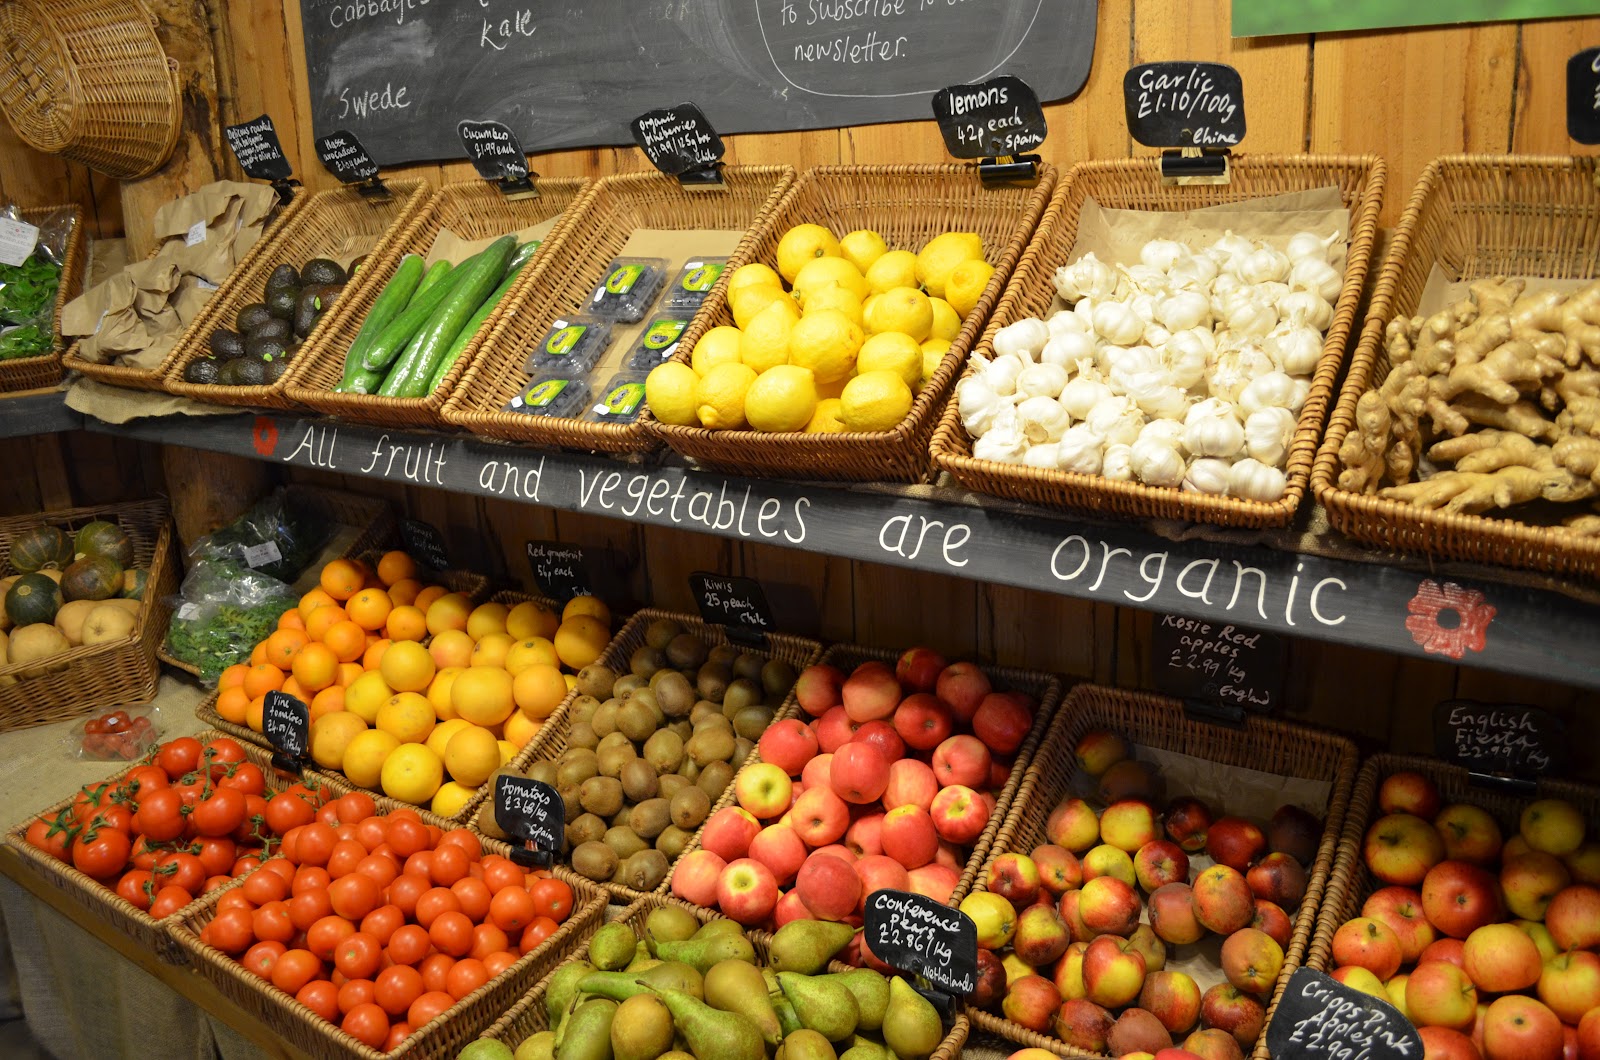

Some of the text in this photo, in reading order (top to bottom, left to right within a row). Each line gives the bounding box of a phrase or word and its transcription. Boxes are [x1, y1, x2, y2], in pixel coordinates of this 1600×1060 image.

[781, 0, 798, 26] to
[480, 8, 537, 51] Kale
[794, 31, 908, 64] newsletter.
[1139, 67, 1214, 93] Garlic
[338, 82, 412, 120] Swede
[949, 87, 1009, 115] lemons
[1138, 90, 1236, 124] £1.10/100g
[642, 120, 696, 146] blueberries
[957, 106, 1023, 148] 42p each
[475, 142, 516, 159] £1.99 each
[283, 425, 1347, 626] All fruit and vegetables are organic
[527, 543, 584, 565] Red grapefruit
[554, 566, 574, 578] each
[703, 578, 732, 593] Kiwis
[1180, 635, 1240, 658] apples
[1218, 625, 1261, 649] Red
[273, 695, 290, 708] Vine
[1447, 706, 1538, 735] English
[1455, 728, 1538, 748] Fiesta
[501, 777, 551, 805] tomatoes
[875, 894, 961, 932] Conference
[1301, 981, 1416, 1056] Cripps Pink
[1308, 1008, 1373, 1047] Apples
